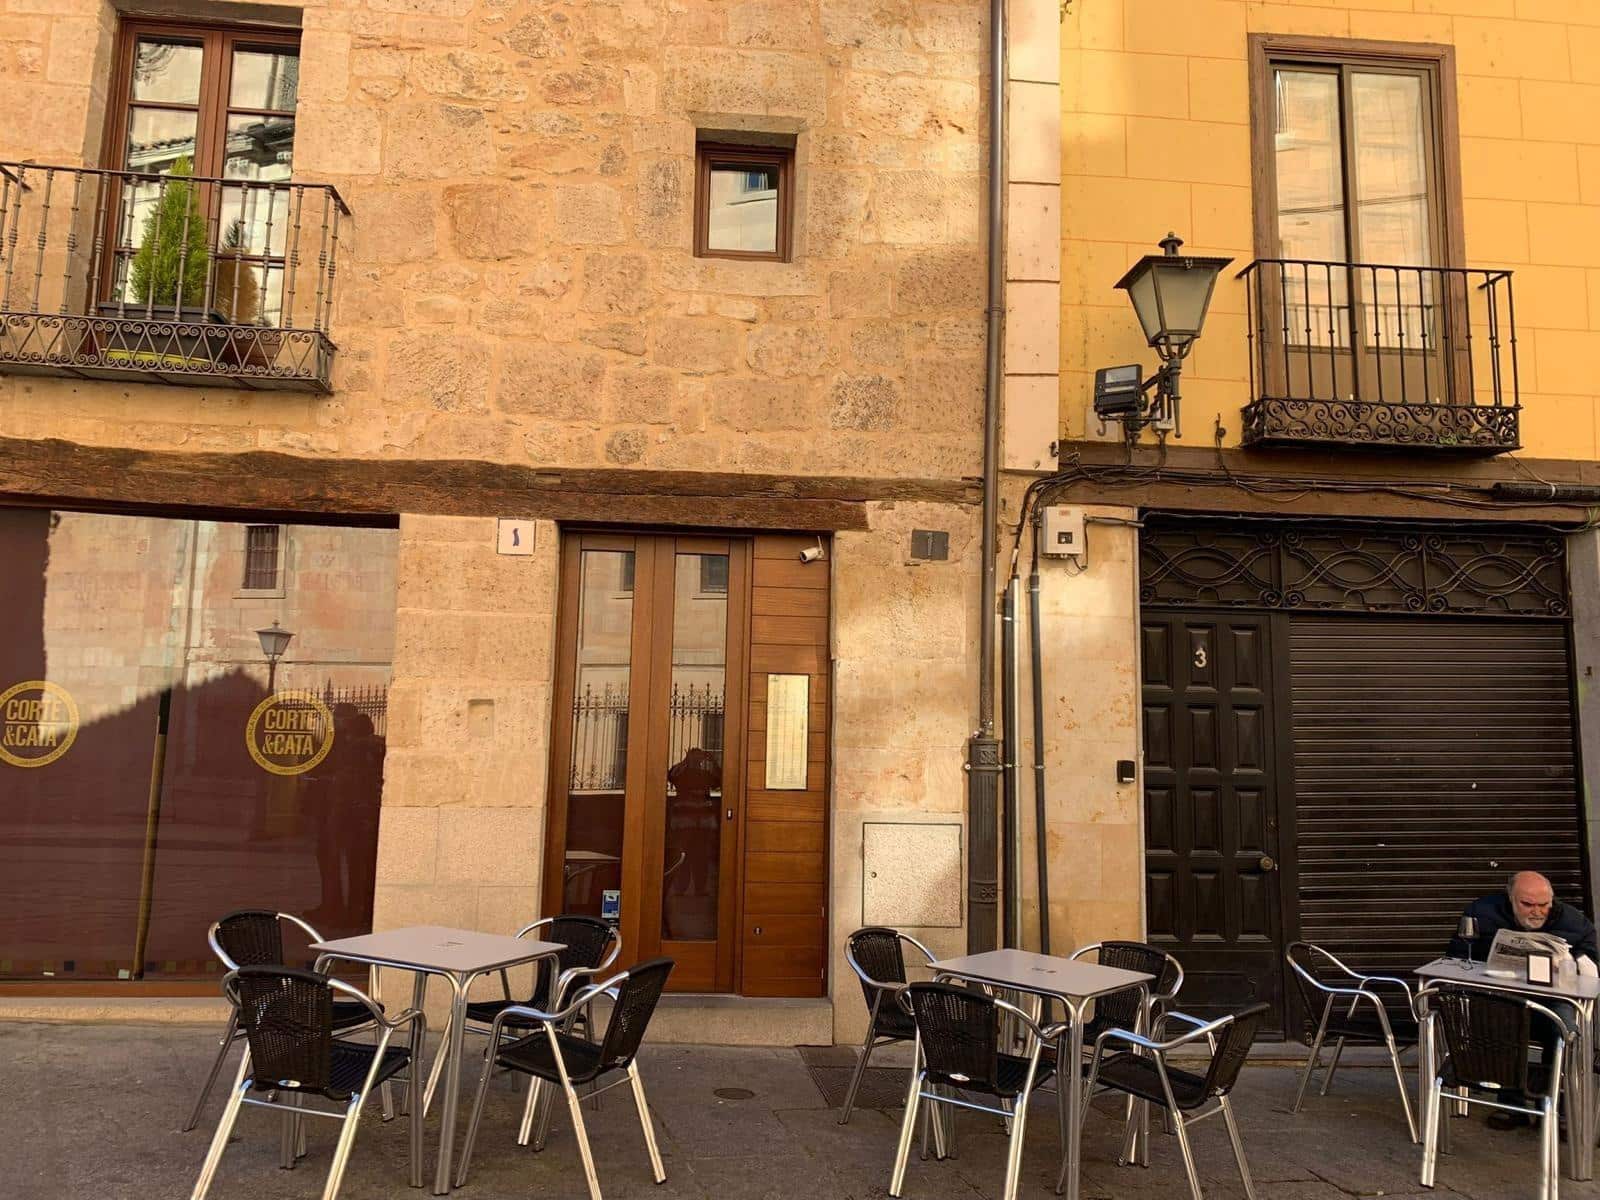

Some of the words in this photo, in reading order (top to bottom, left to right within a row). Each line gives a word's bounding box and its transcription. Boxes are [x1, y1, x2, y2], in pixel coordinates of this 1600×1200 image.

[1194, 648, 1207, 668] 3
[6, 699, 62, 721] CORTE
[265, 708, 316, 731] CORTE
[3, 725, 57, 747] &CATA
[262, 734, 314, 756] &CATA
